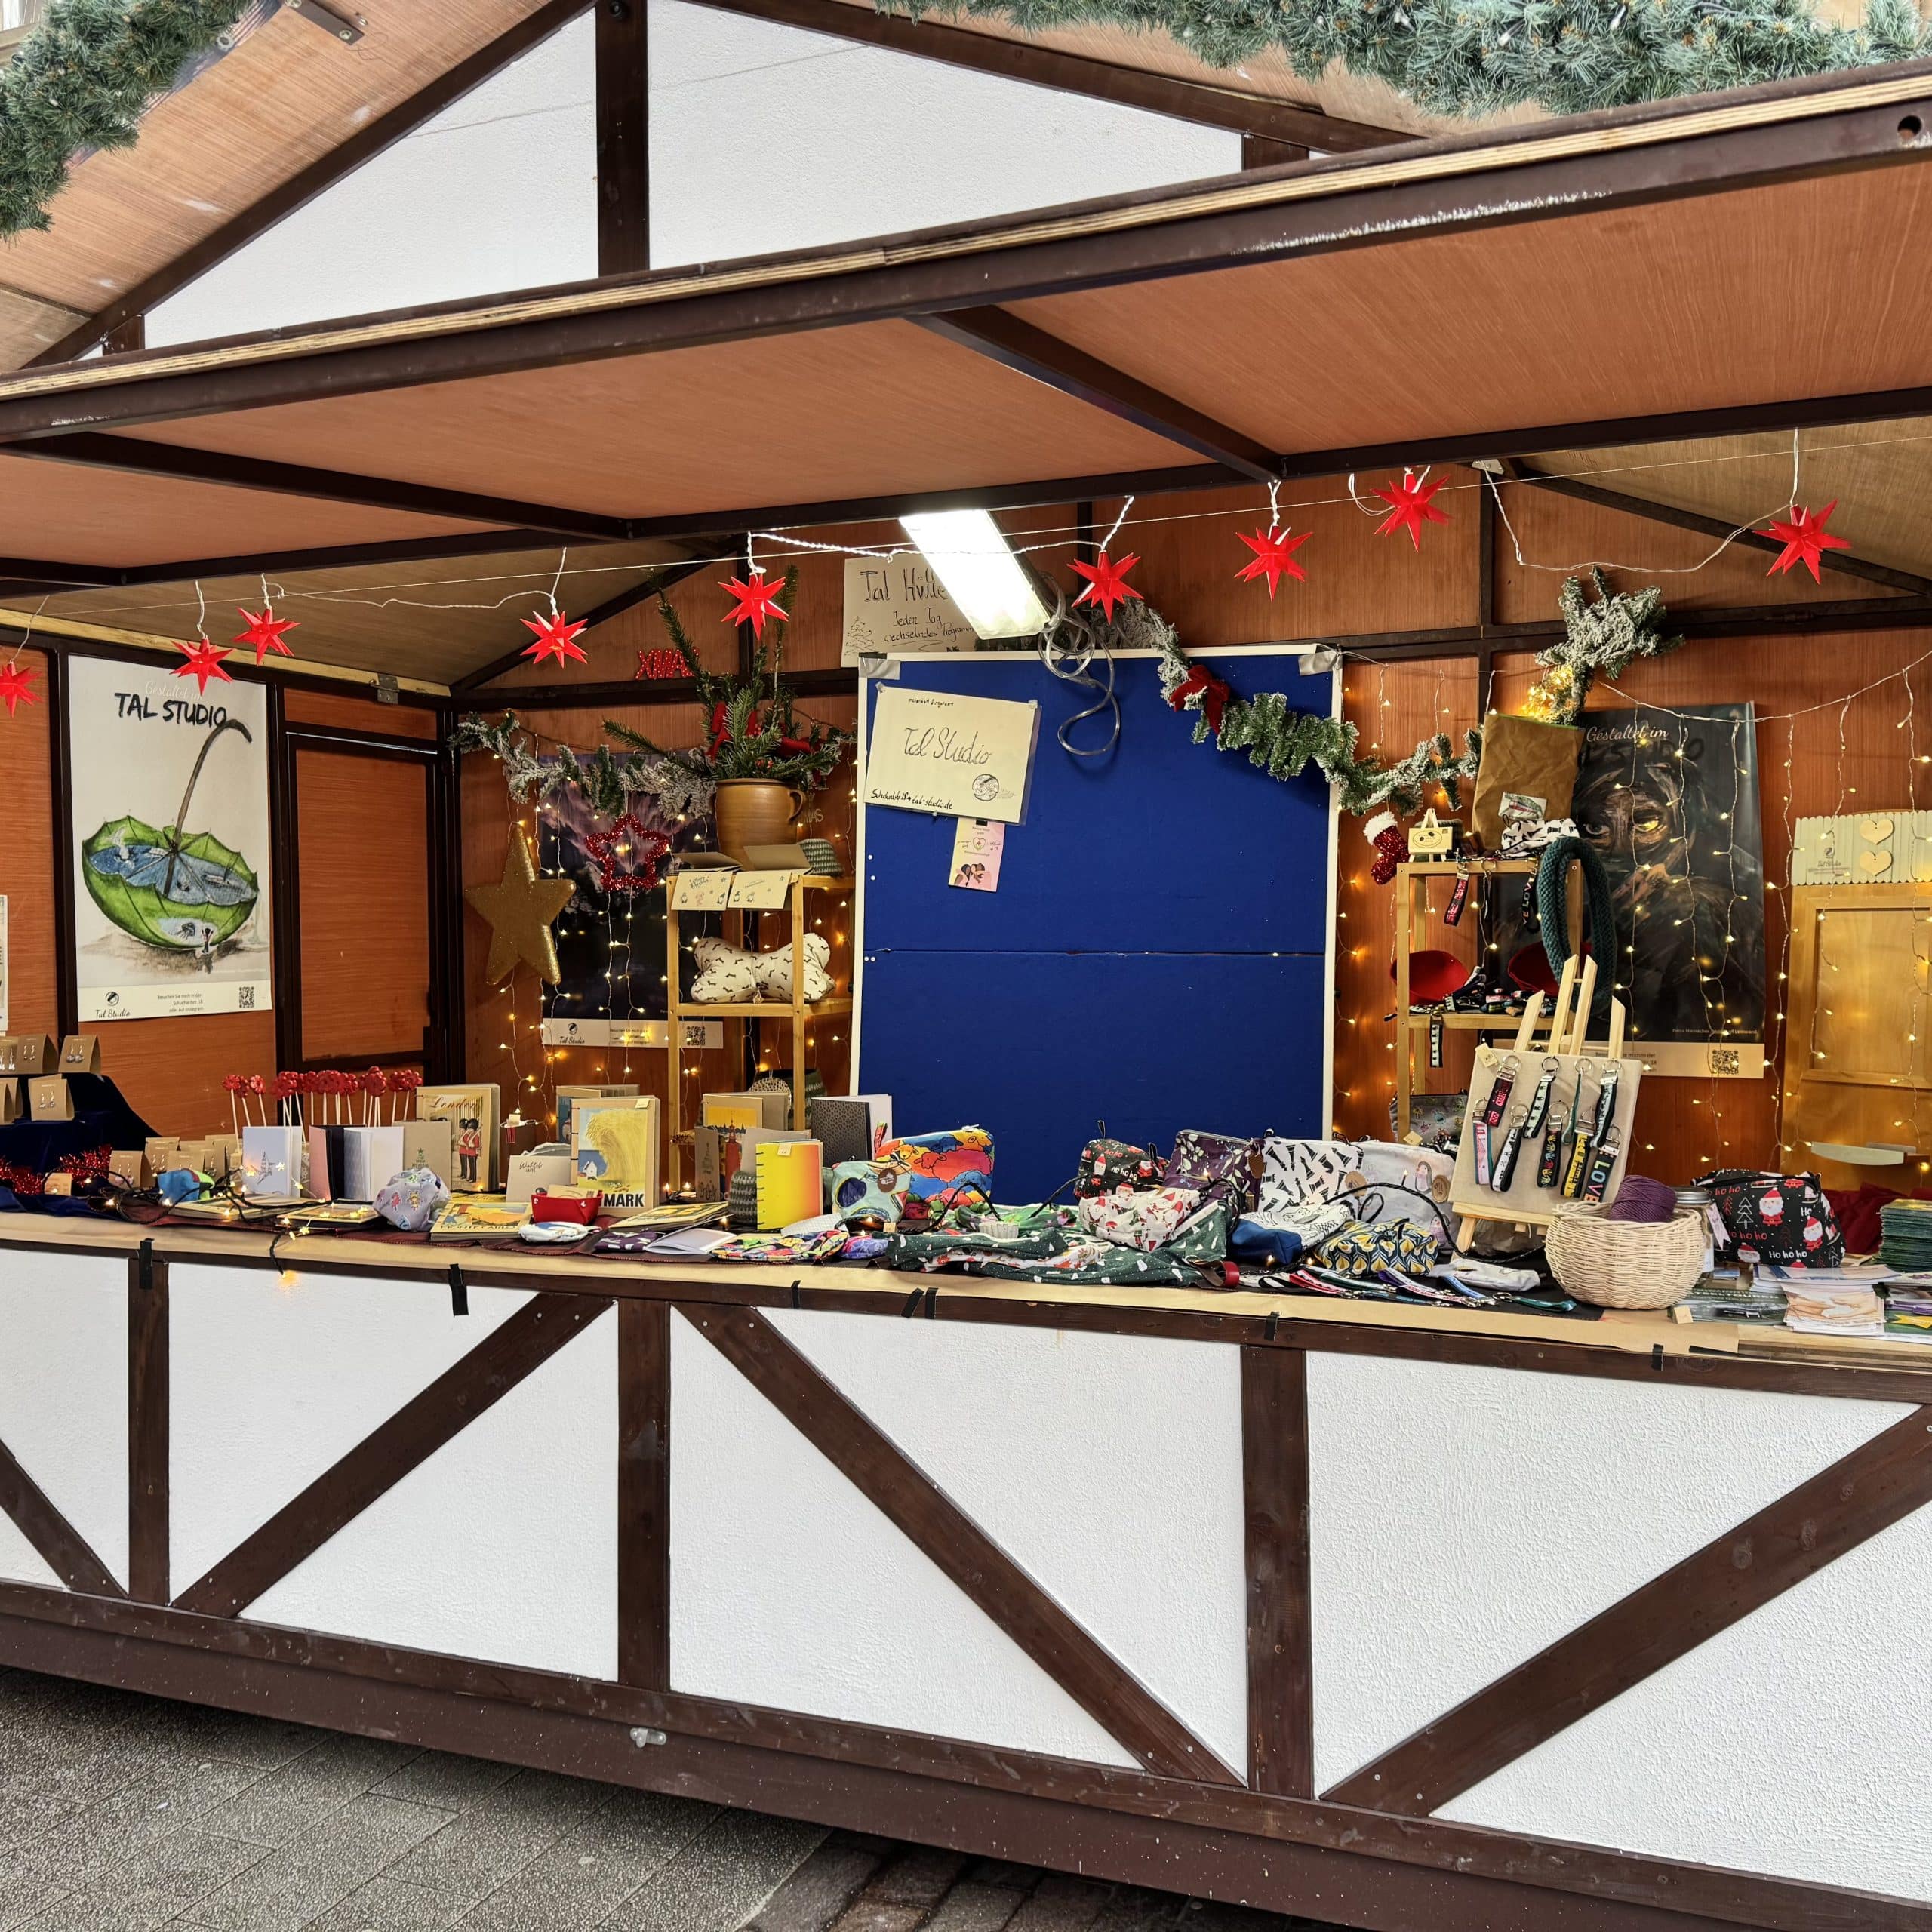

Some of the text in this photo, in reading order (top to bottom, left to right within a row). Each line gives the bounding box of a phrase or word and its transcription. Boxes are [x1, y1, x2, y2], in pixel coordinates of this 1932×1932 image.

[860, 570, 891, 602] Tal
[925, 607, 943, 630] Tag
[635, 646, 700, 679] XMA
[114, 692, 227, 728] TAL STUDIO
[1586, 724, 1669, 742] Gestaltet im
[933, 726, 993, 765] Studio
[94, 1008, 131, 1019] Tal Studio
[559, 1036, 585, 1044] Tal Studio
[429, 1096, 478, 1109] London
[1584, 1160, 1611, 1201] LOVE
[1728, 1186, 1741, 1195] ho
[601, 1193, 645, 1208] MARK
[1740, 1231, 1752, 1240] ho
[1754, 1231, 1768, 1241] ho
[1769, 1250, 1808, 1259] Ho ho ho
